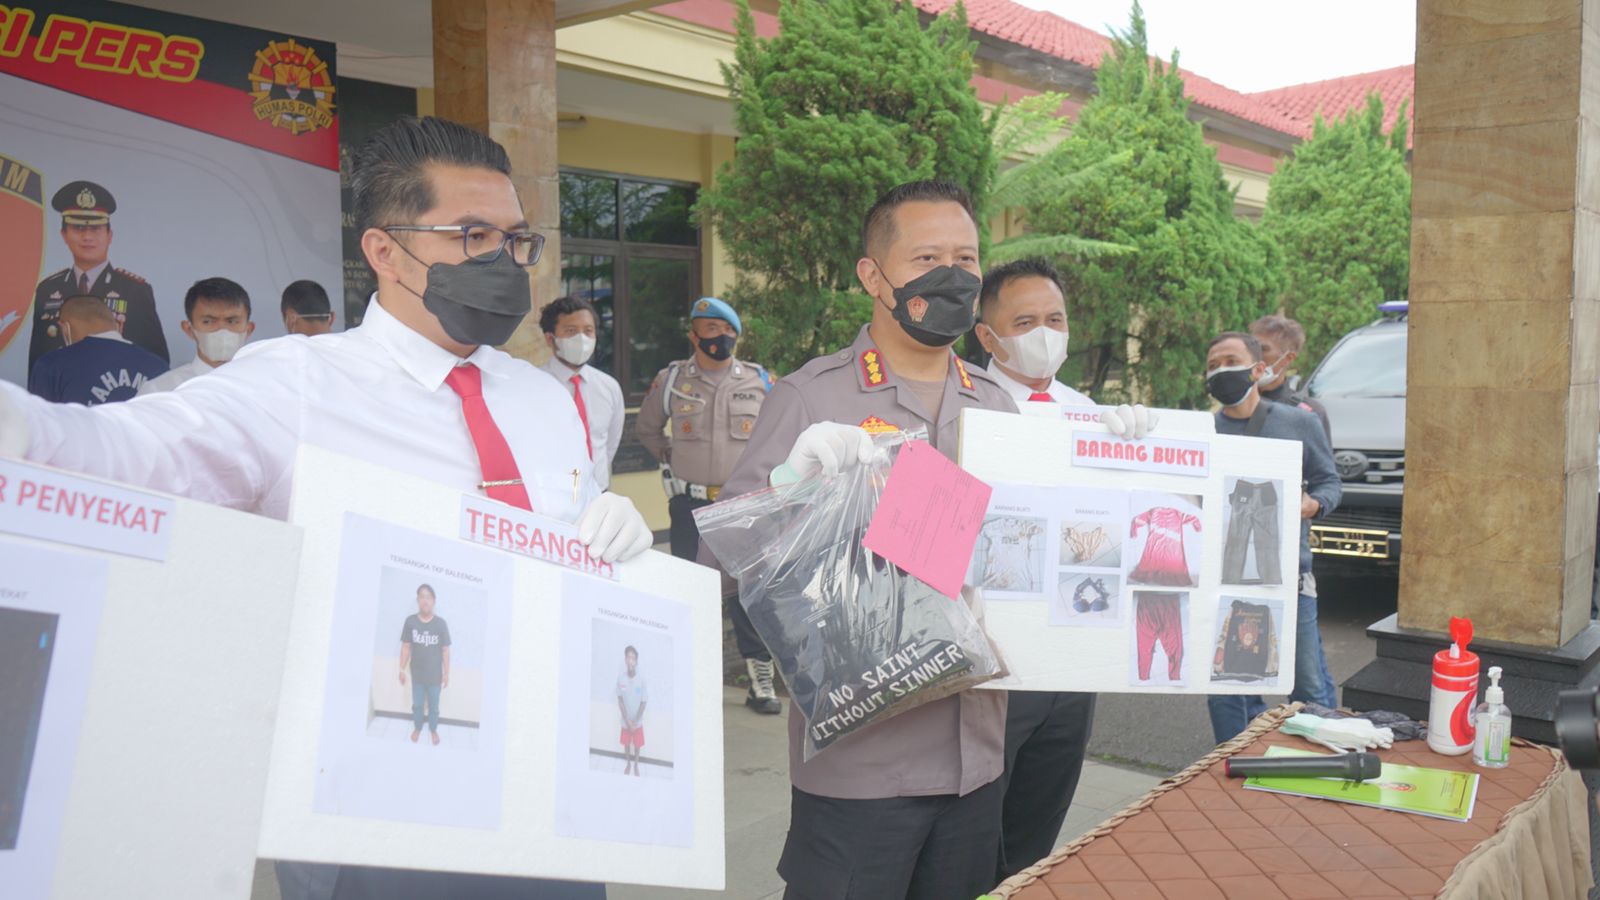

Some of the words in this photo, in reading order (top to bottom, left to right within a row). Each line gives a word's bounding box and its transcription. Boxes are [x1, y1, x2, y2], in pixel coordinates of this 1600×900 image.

[34, 14, 204, 82] PERS
[256, 100, 296, 118] HUMAS
[297, 102, 332, 127] POLRI
[1076, 439, 1148, 462] BARANG
[1153, 446, 1205, 467] BUKTI
[16, 479, 167, 534] PENYEKAT
[828, 684, 854, 708] NO
[861, 642, 922, 689] SAINT
[889, 643, 964, 698] SINNER
